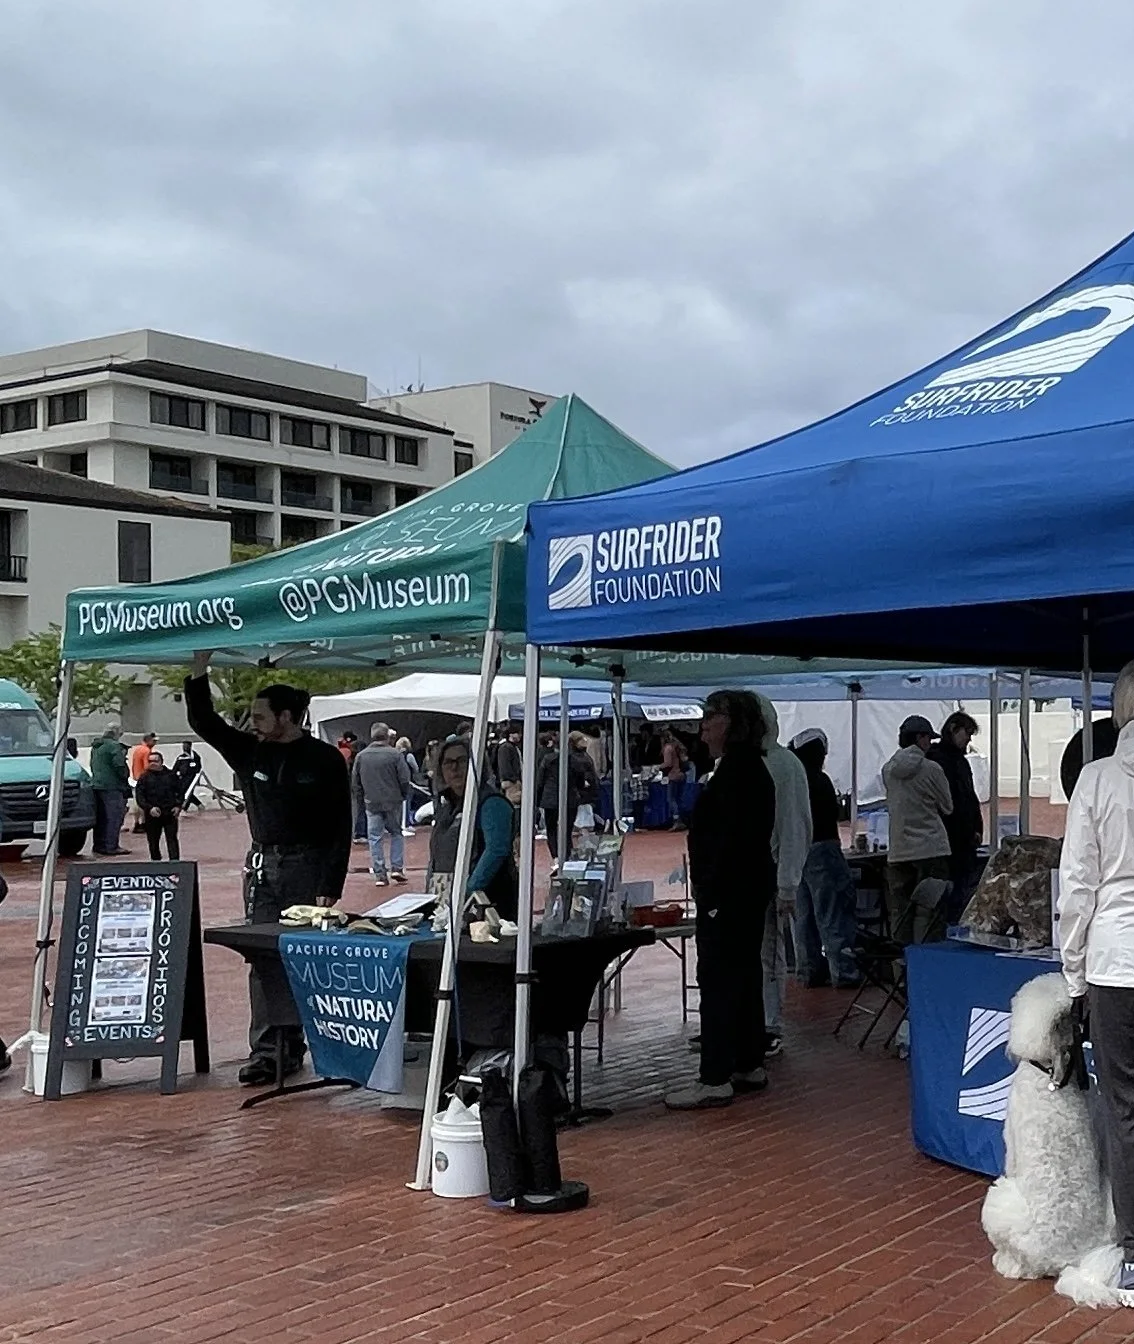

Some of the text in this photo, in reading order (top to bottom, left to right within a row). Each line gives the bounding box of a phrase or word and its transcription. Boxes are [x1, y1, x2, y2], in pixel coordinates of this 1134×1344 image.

[893, 376, 1061, 413] SURFRIDER
[869, 397, 1036, 427] FOUNDATION
[450, 502, 524, 513] GROVE
[595, 516, 722, 574] SURFRIDER
[594, 565, 721, 605] FOUNDATION
[79, 597, 243, 635] PGMuseum.org
[279, 572, 470, 622] @PGMuseum
[101, 876, 166, 890] EVENTOS
[69, 892, 95, 1027] UPCOMING
[287, 944, 388, 958] PACIFIC GROVE
[290, 961, 402, 994] MUSEUM
[84, 1025, 153, 1043] EVENTS
